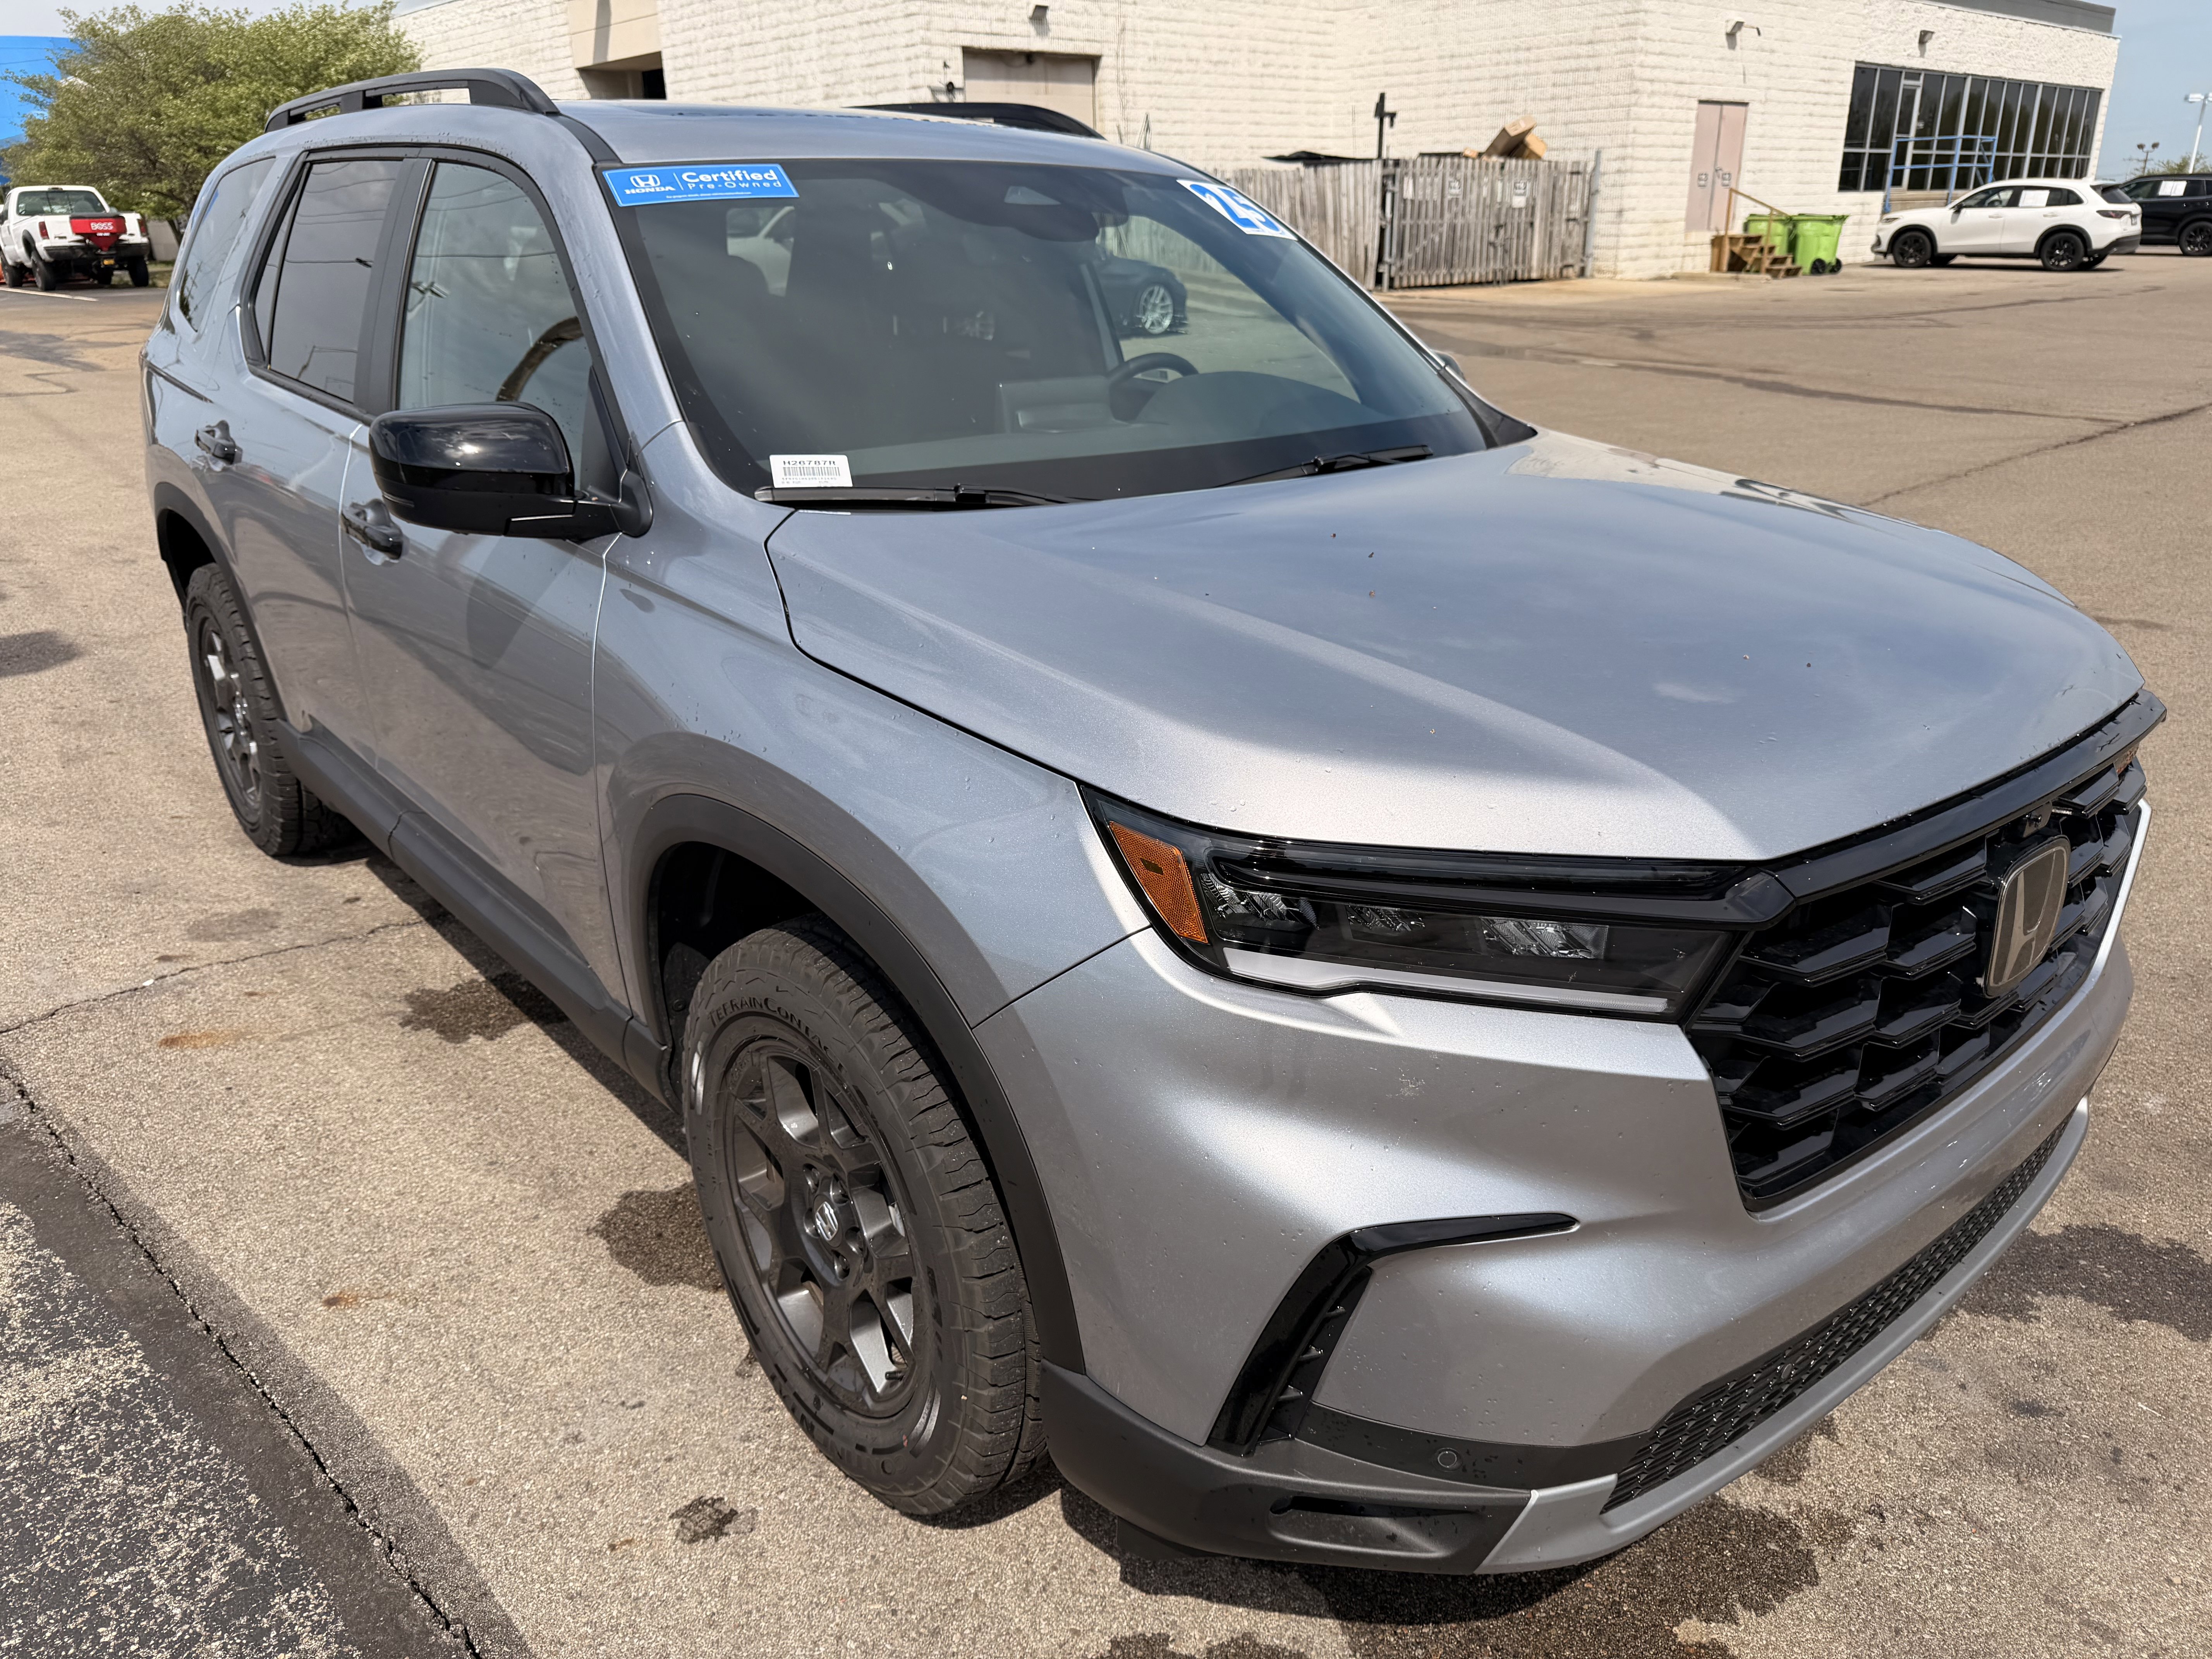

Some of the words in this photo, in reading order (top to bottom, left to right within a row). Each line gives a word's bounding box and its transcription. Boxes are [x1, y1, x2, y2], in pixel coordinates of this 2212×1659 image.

[682, 169, 778, 182] Certified
[624, 186, 676, 194] HONDA
[687, 180, 782, 190] Pre-Owned
[1189, 183, 1285, 232] 25
[91, 222, 114, 230] BOSS
